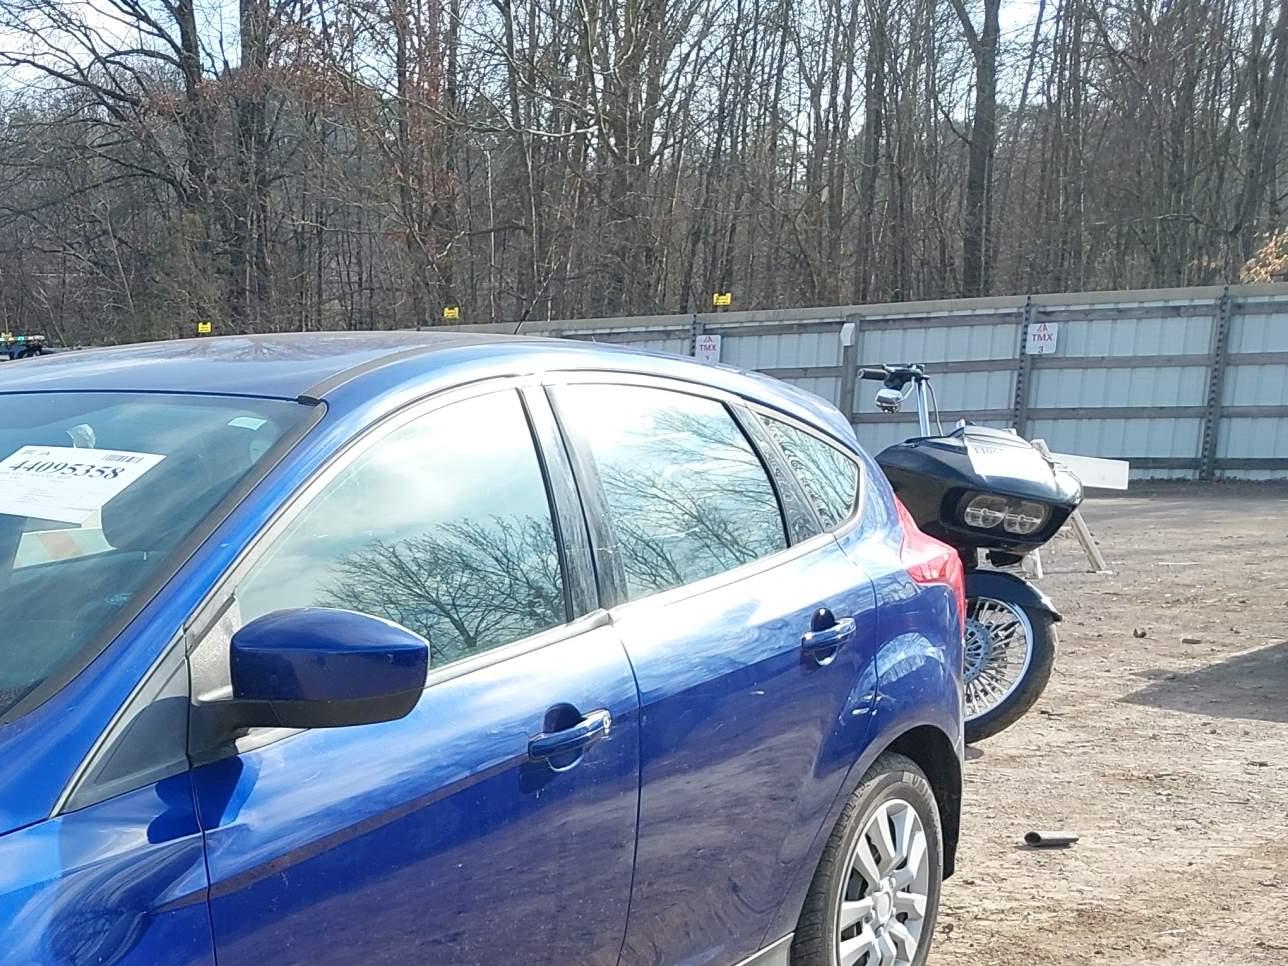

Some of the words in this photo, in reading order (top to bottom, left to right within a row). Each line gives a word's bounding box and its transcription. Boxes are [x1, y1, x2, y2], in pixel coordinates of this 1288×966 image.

[1032, 333, 1053, 342] TMX
[699, 344, 717, 352] TMX
[9, 459, 126, 480] 44095358
